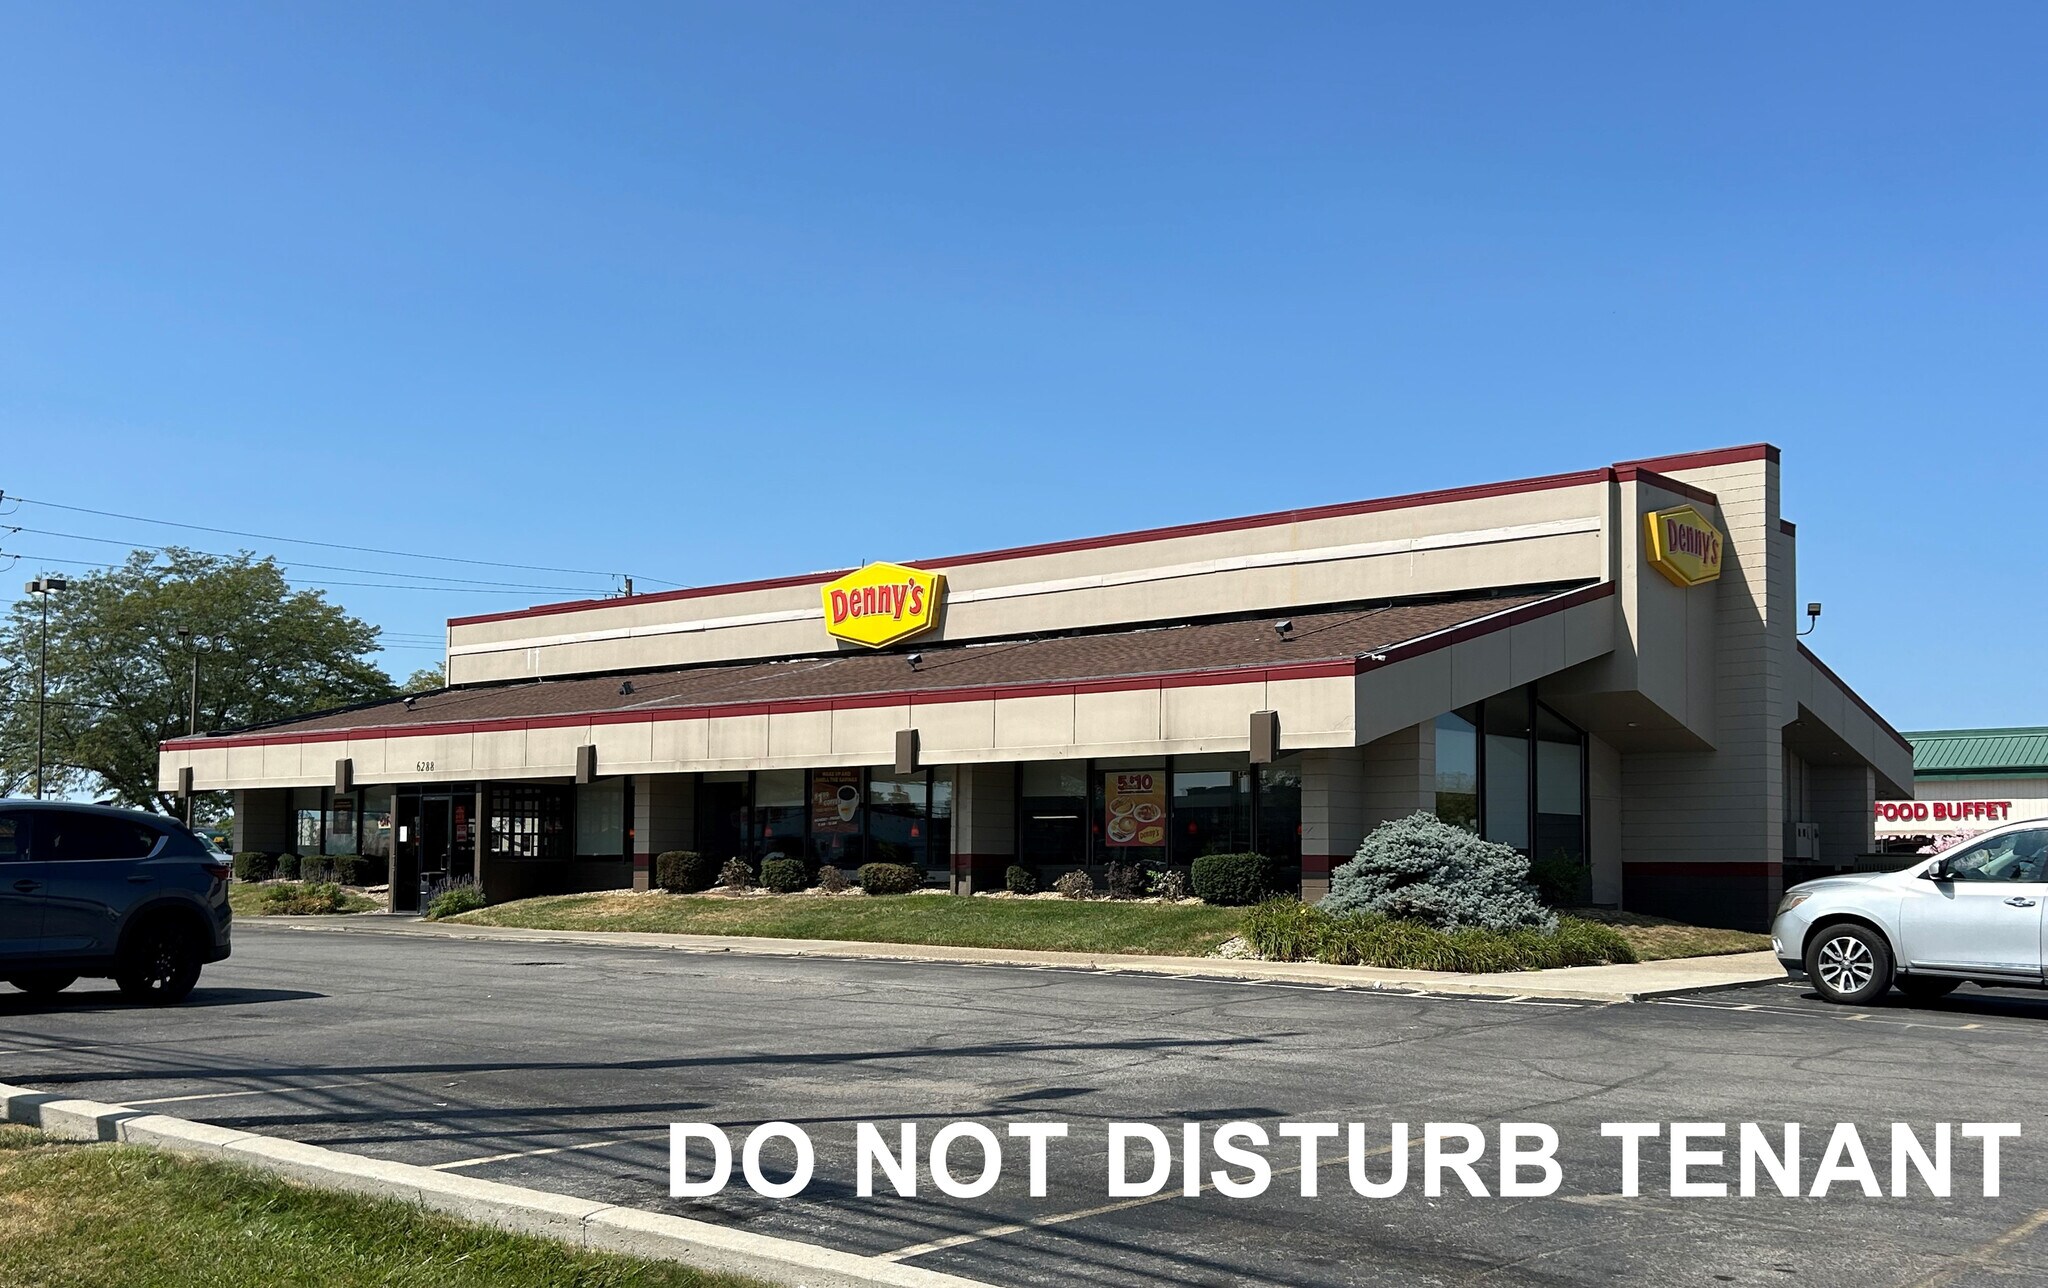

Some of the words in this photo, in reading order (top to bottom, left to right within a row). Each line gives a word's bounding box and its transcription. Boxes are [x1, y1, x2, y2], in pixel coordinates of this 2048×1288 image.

[1666, 518, 1720, 565] Denny's
[830, 578, 924, 625] Denny's
[416, 761, 435, 772] 6288
[1874, 802, 1929, 822] FOOD
[1933, 801, 2012, 821] BUFFET
